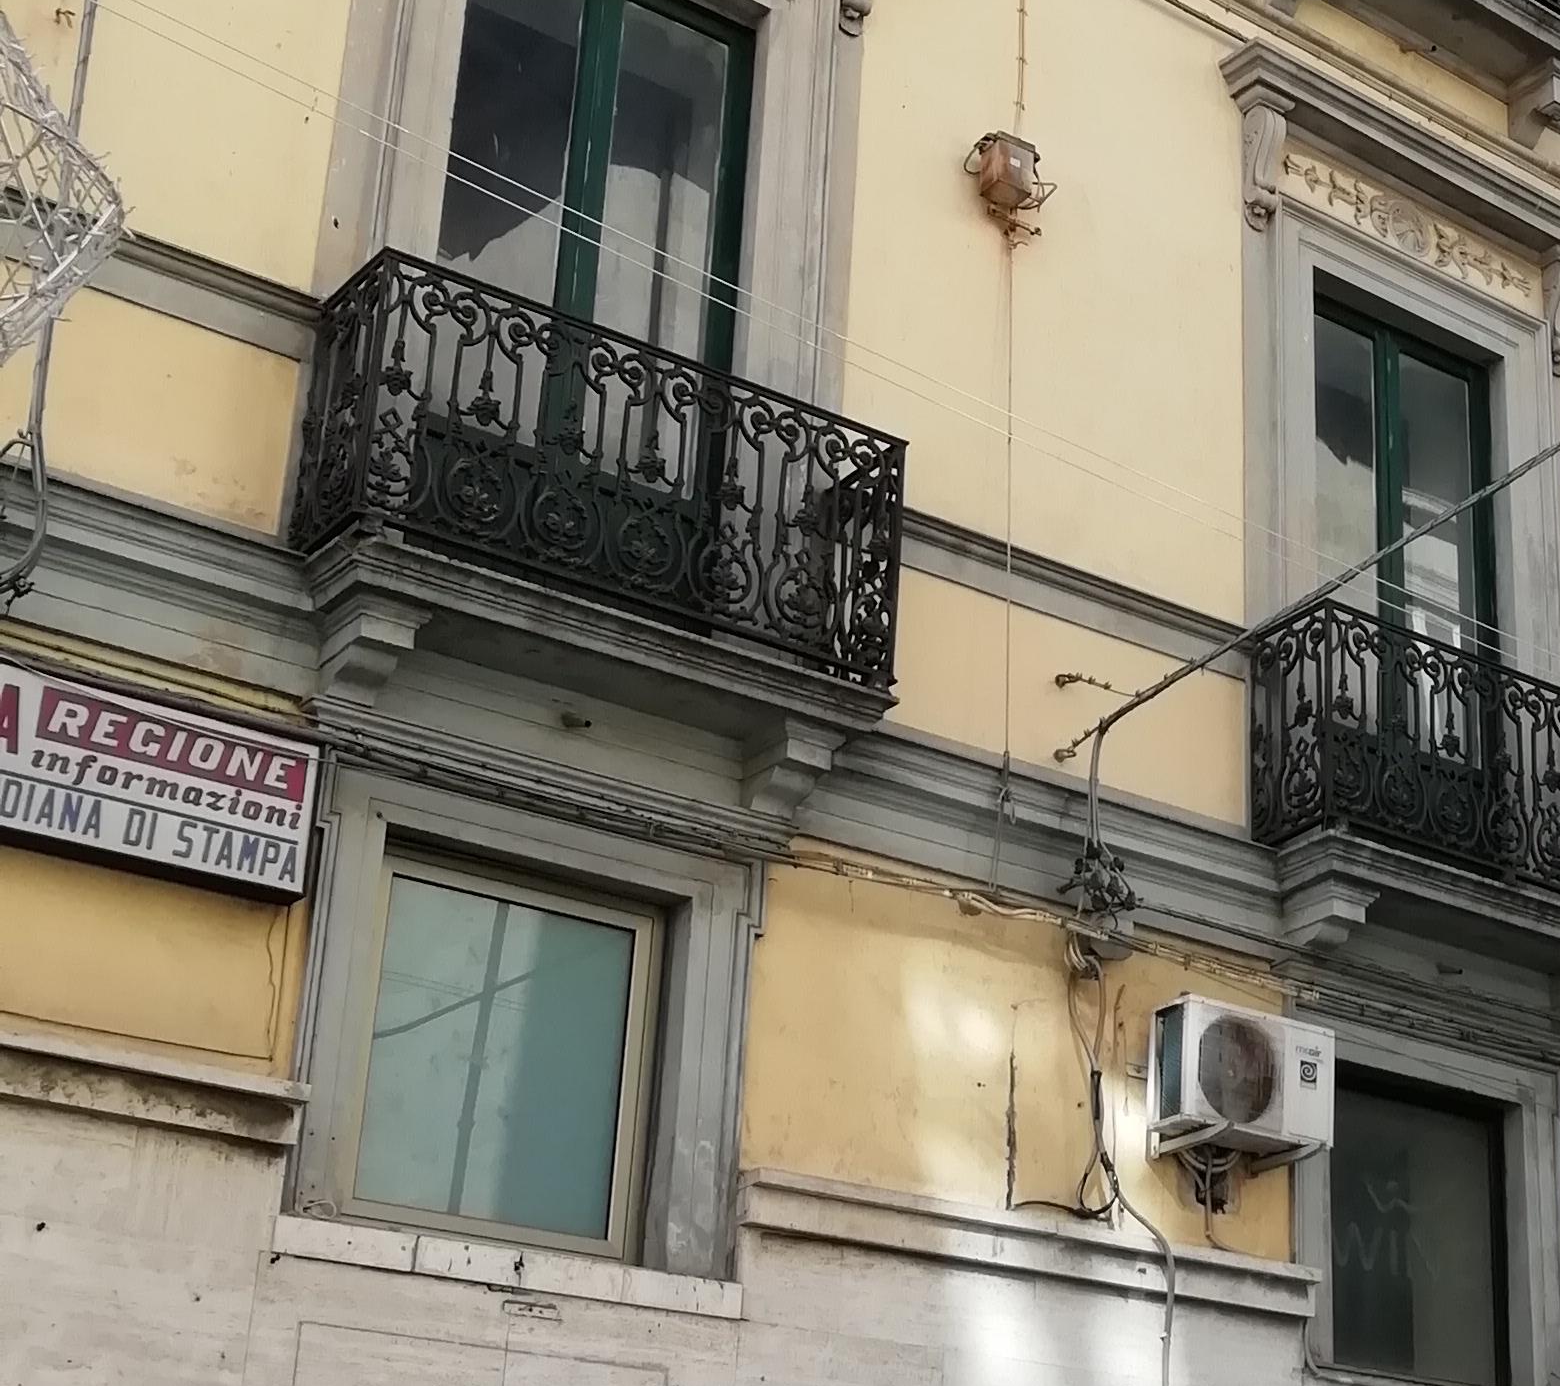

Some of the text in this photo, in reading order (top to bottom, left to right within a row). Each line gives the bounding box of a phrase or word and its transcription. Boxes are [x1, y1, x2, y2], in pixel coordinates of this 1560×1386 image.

[46, 699, 297, 790] REGIONE
[30, 749, 303, 831] informazioni
[122, 807, 158, 851] DI
[172, 819, 298, 884] STAMPA
